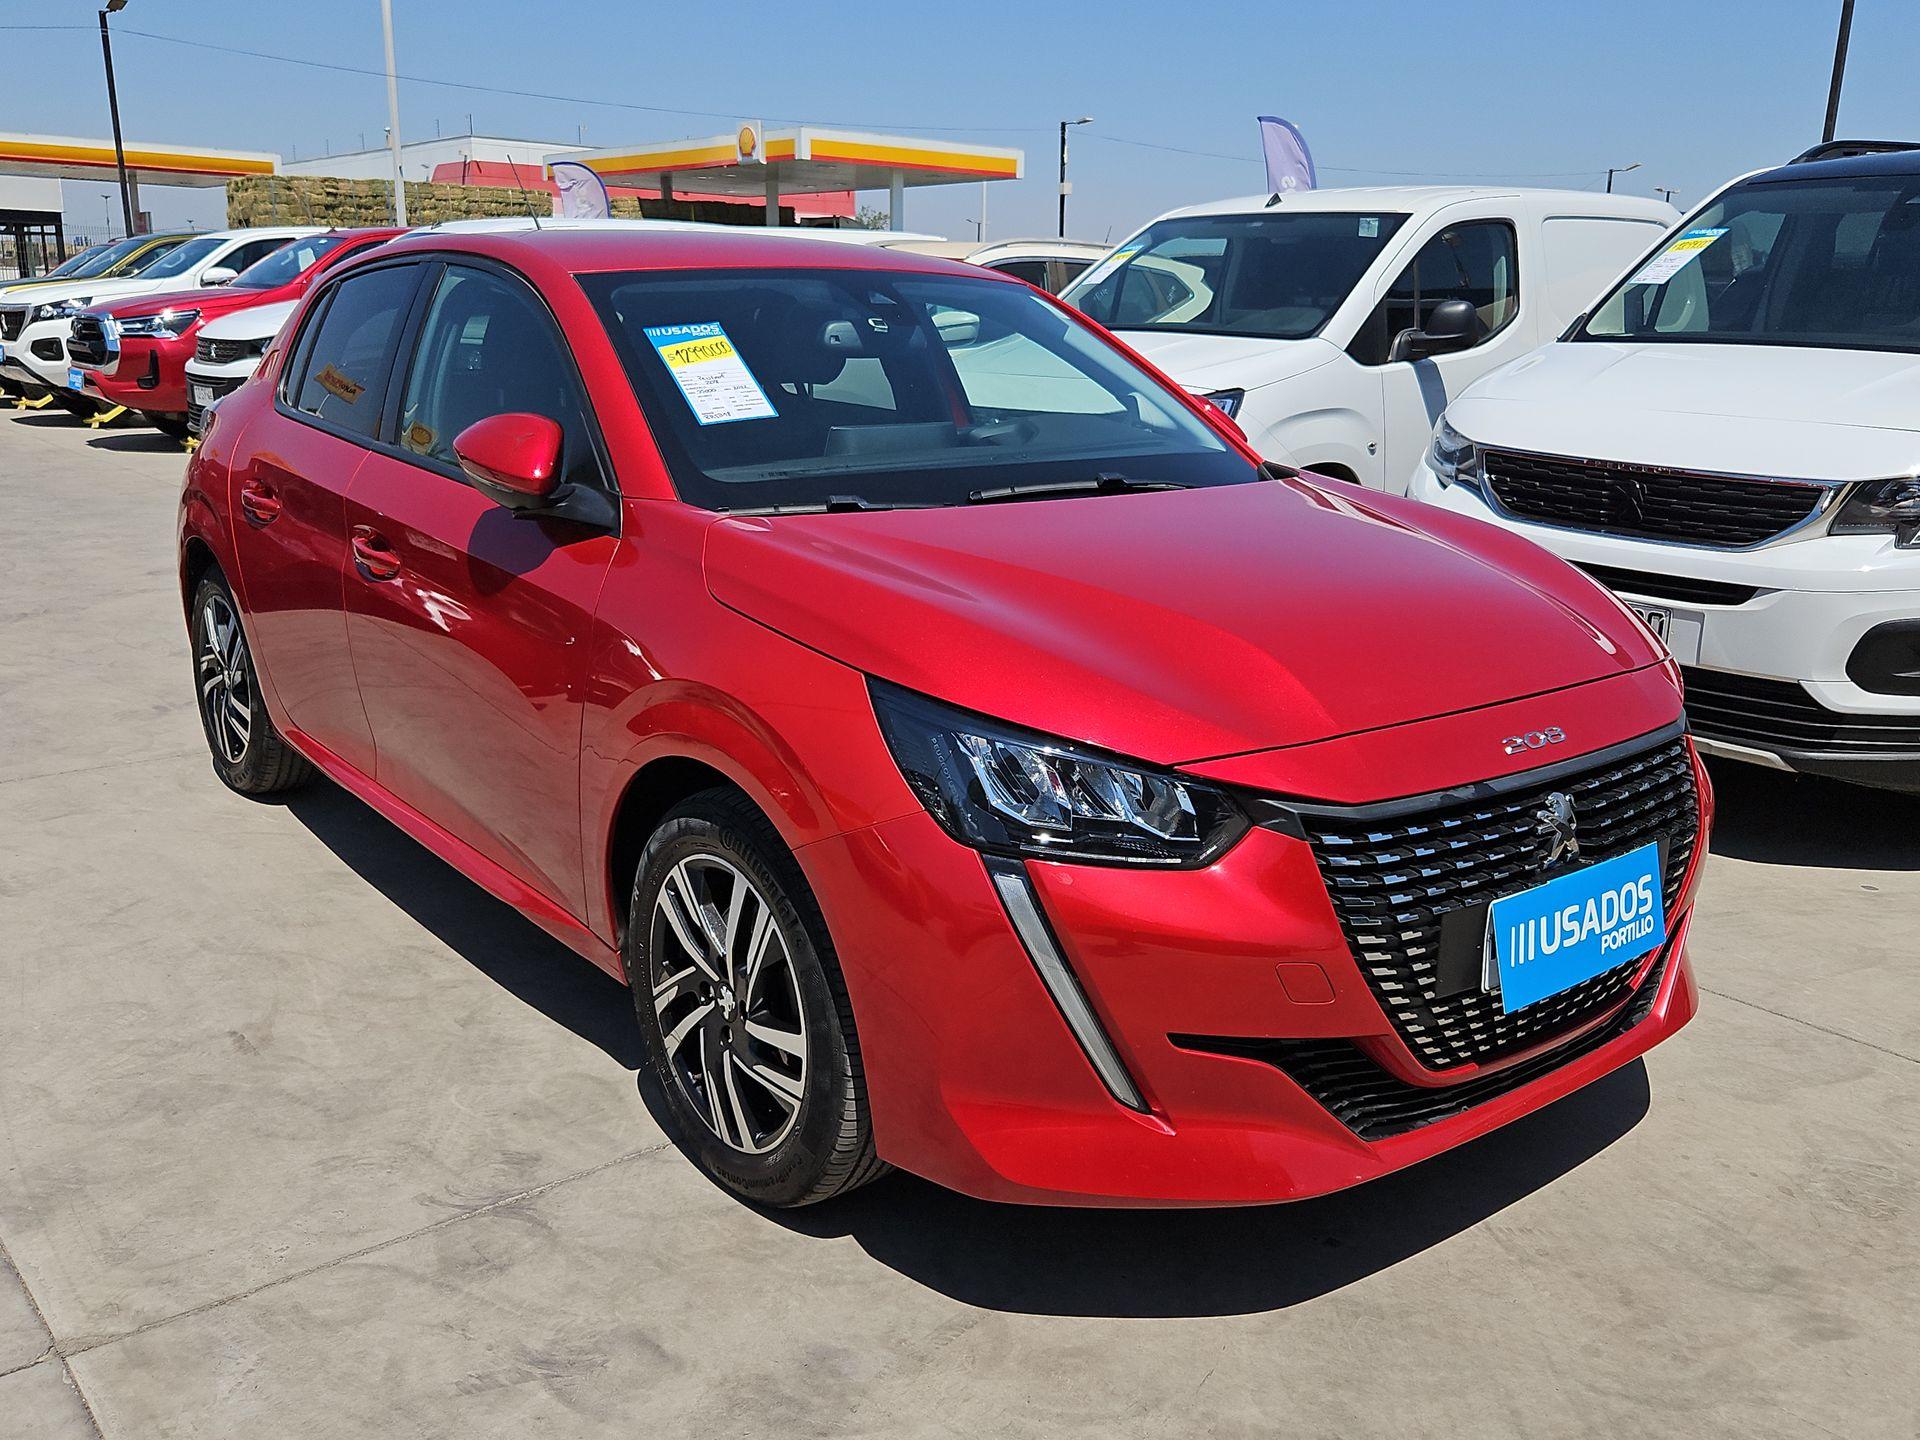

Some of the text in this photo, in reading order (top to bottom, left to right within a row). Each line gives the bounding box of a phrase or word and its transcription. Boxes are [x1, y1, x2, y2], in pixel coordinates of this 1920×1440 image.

[660, 324, 719, 336] USADOS
[931, 737, 952, 781] PEUGEOT
[1502, 727, 1566, 755] 208
[1540, 874, 1653, 955] USADOS
[1601, 914, 1654, 955] PORTILLO
